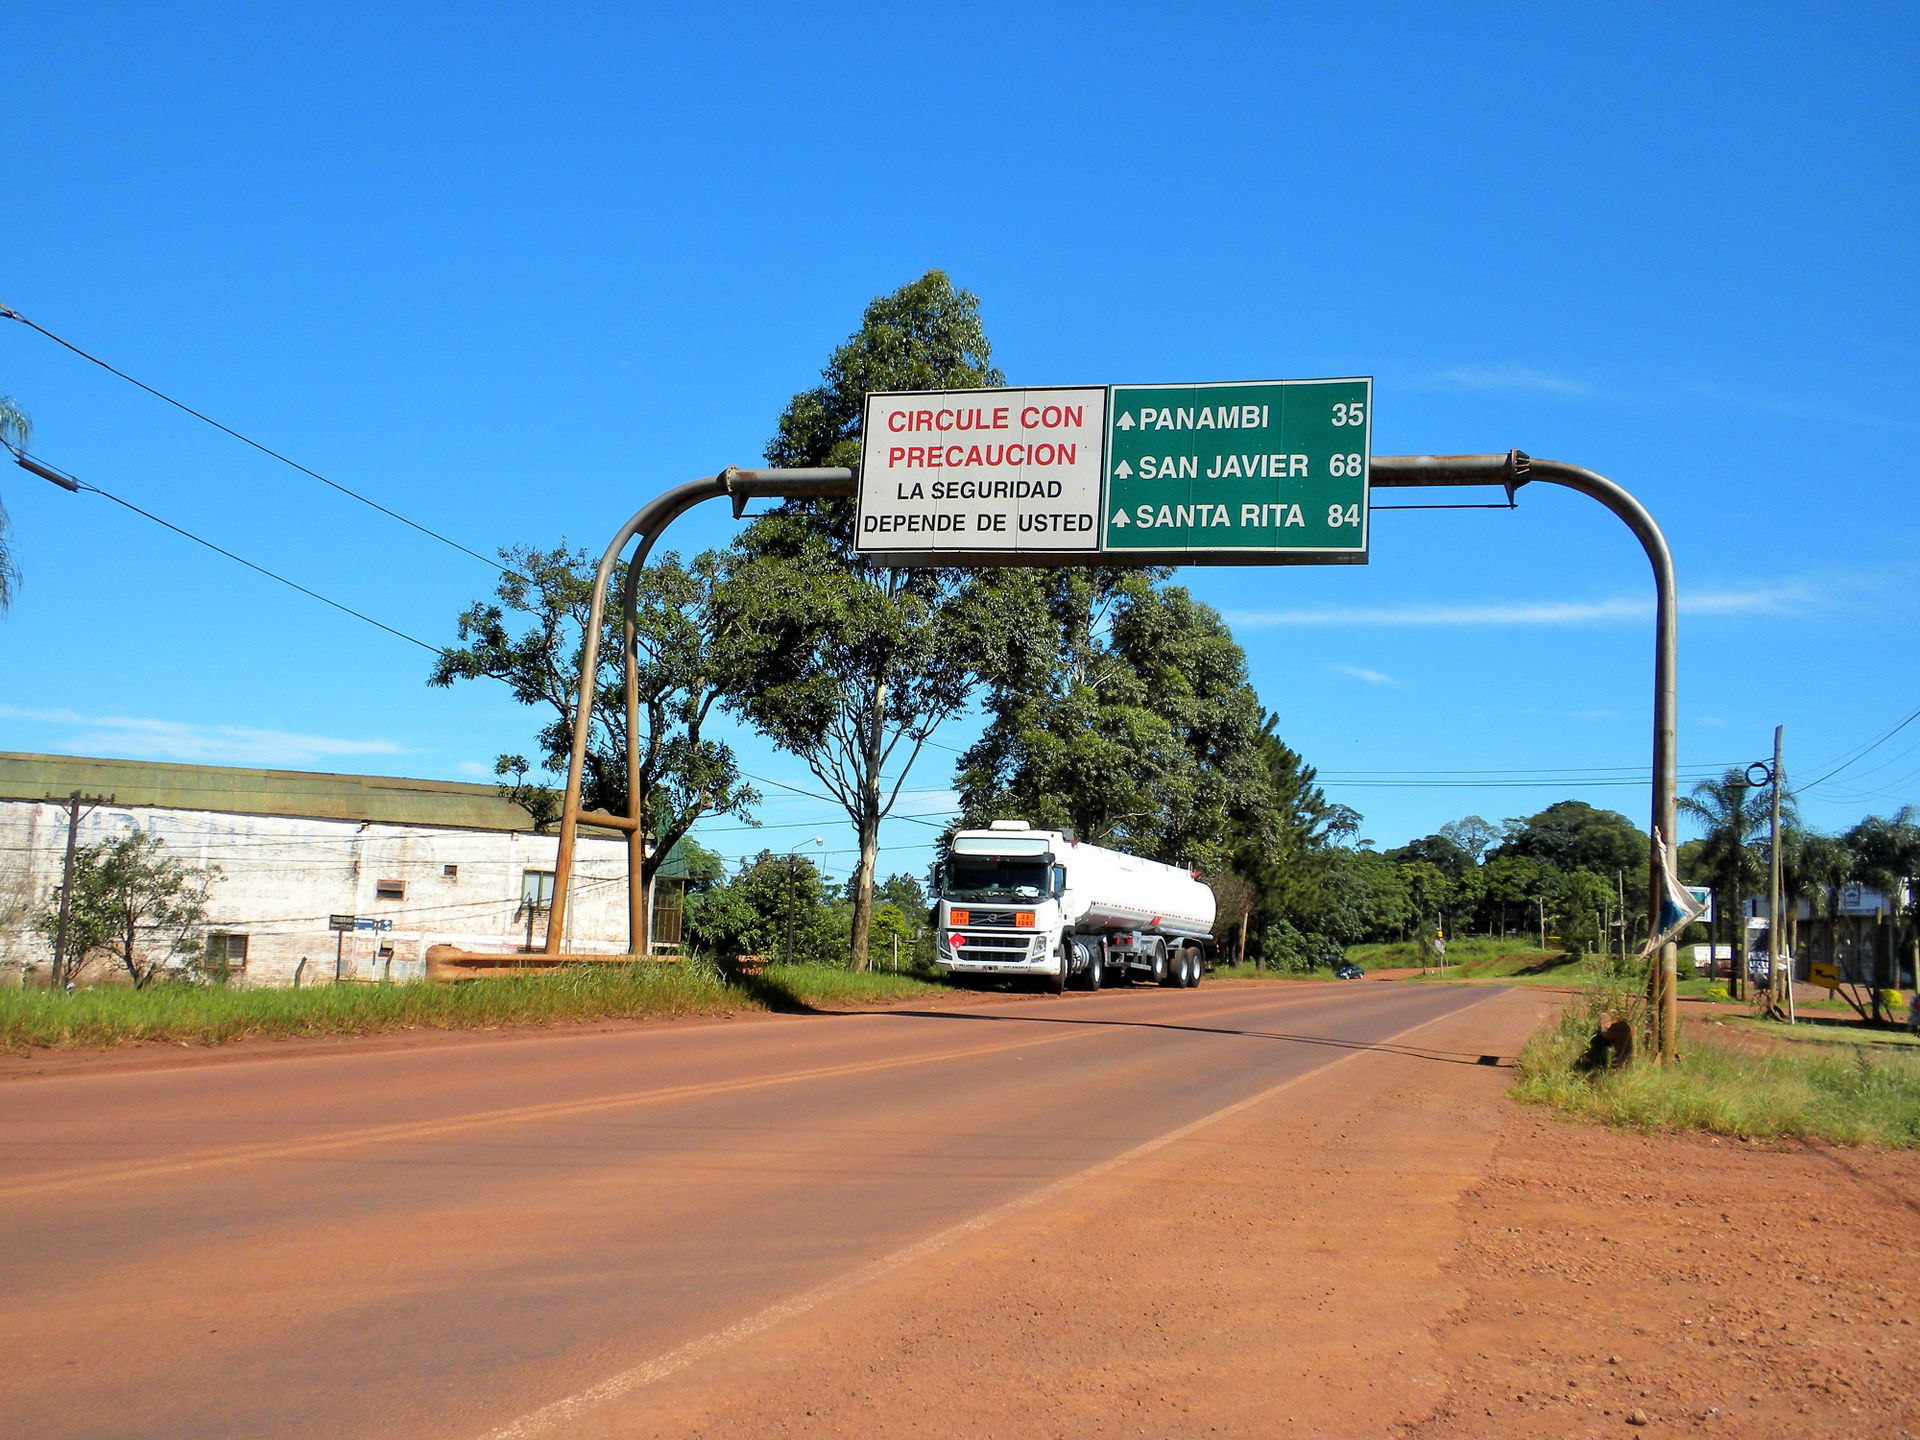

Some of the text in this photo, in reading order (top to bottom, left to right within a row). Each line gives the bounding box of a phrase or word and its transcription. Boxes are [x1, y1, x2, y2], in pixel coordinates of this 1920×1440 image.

[887, 406, 1083, 433] CIRCULE CON
[1139, 402, 1364, 431] PANAMBI 35
[888, 442, 1077, 468] PRECAUCION
[1138, 453, 1362, 480] SAN JAVIER 68
[897, 480, 1062, 500] LA SEGURIDAD
[863, 513, 1093, 534] DEPENDE DE USTED
[1136, 503, 1361, 529] SANTA RITA 84
